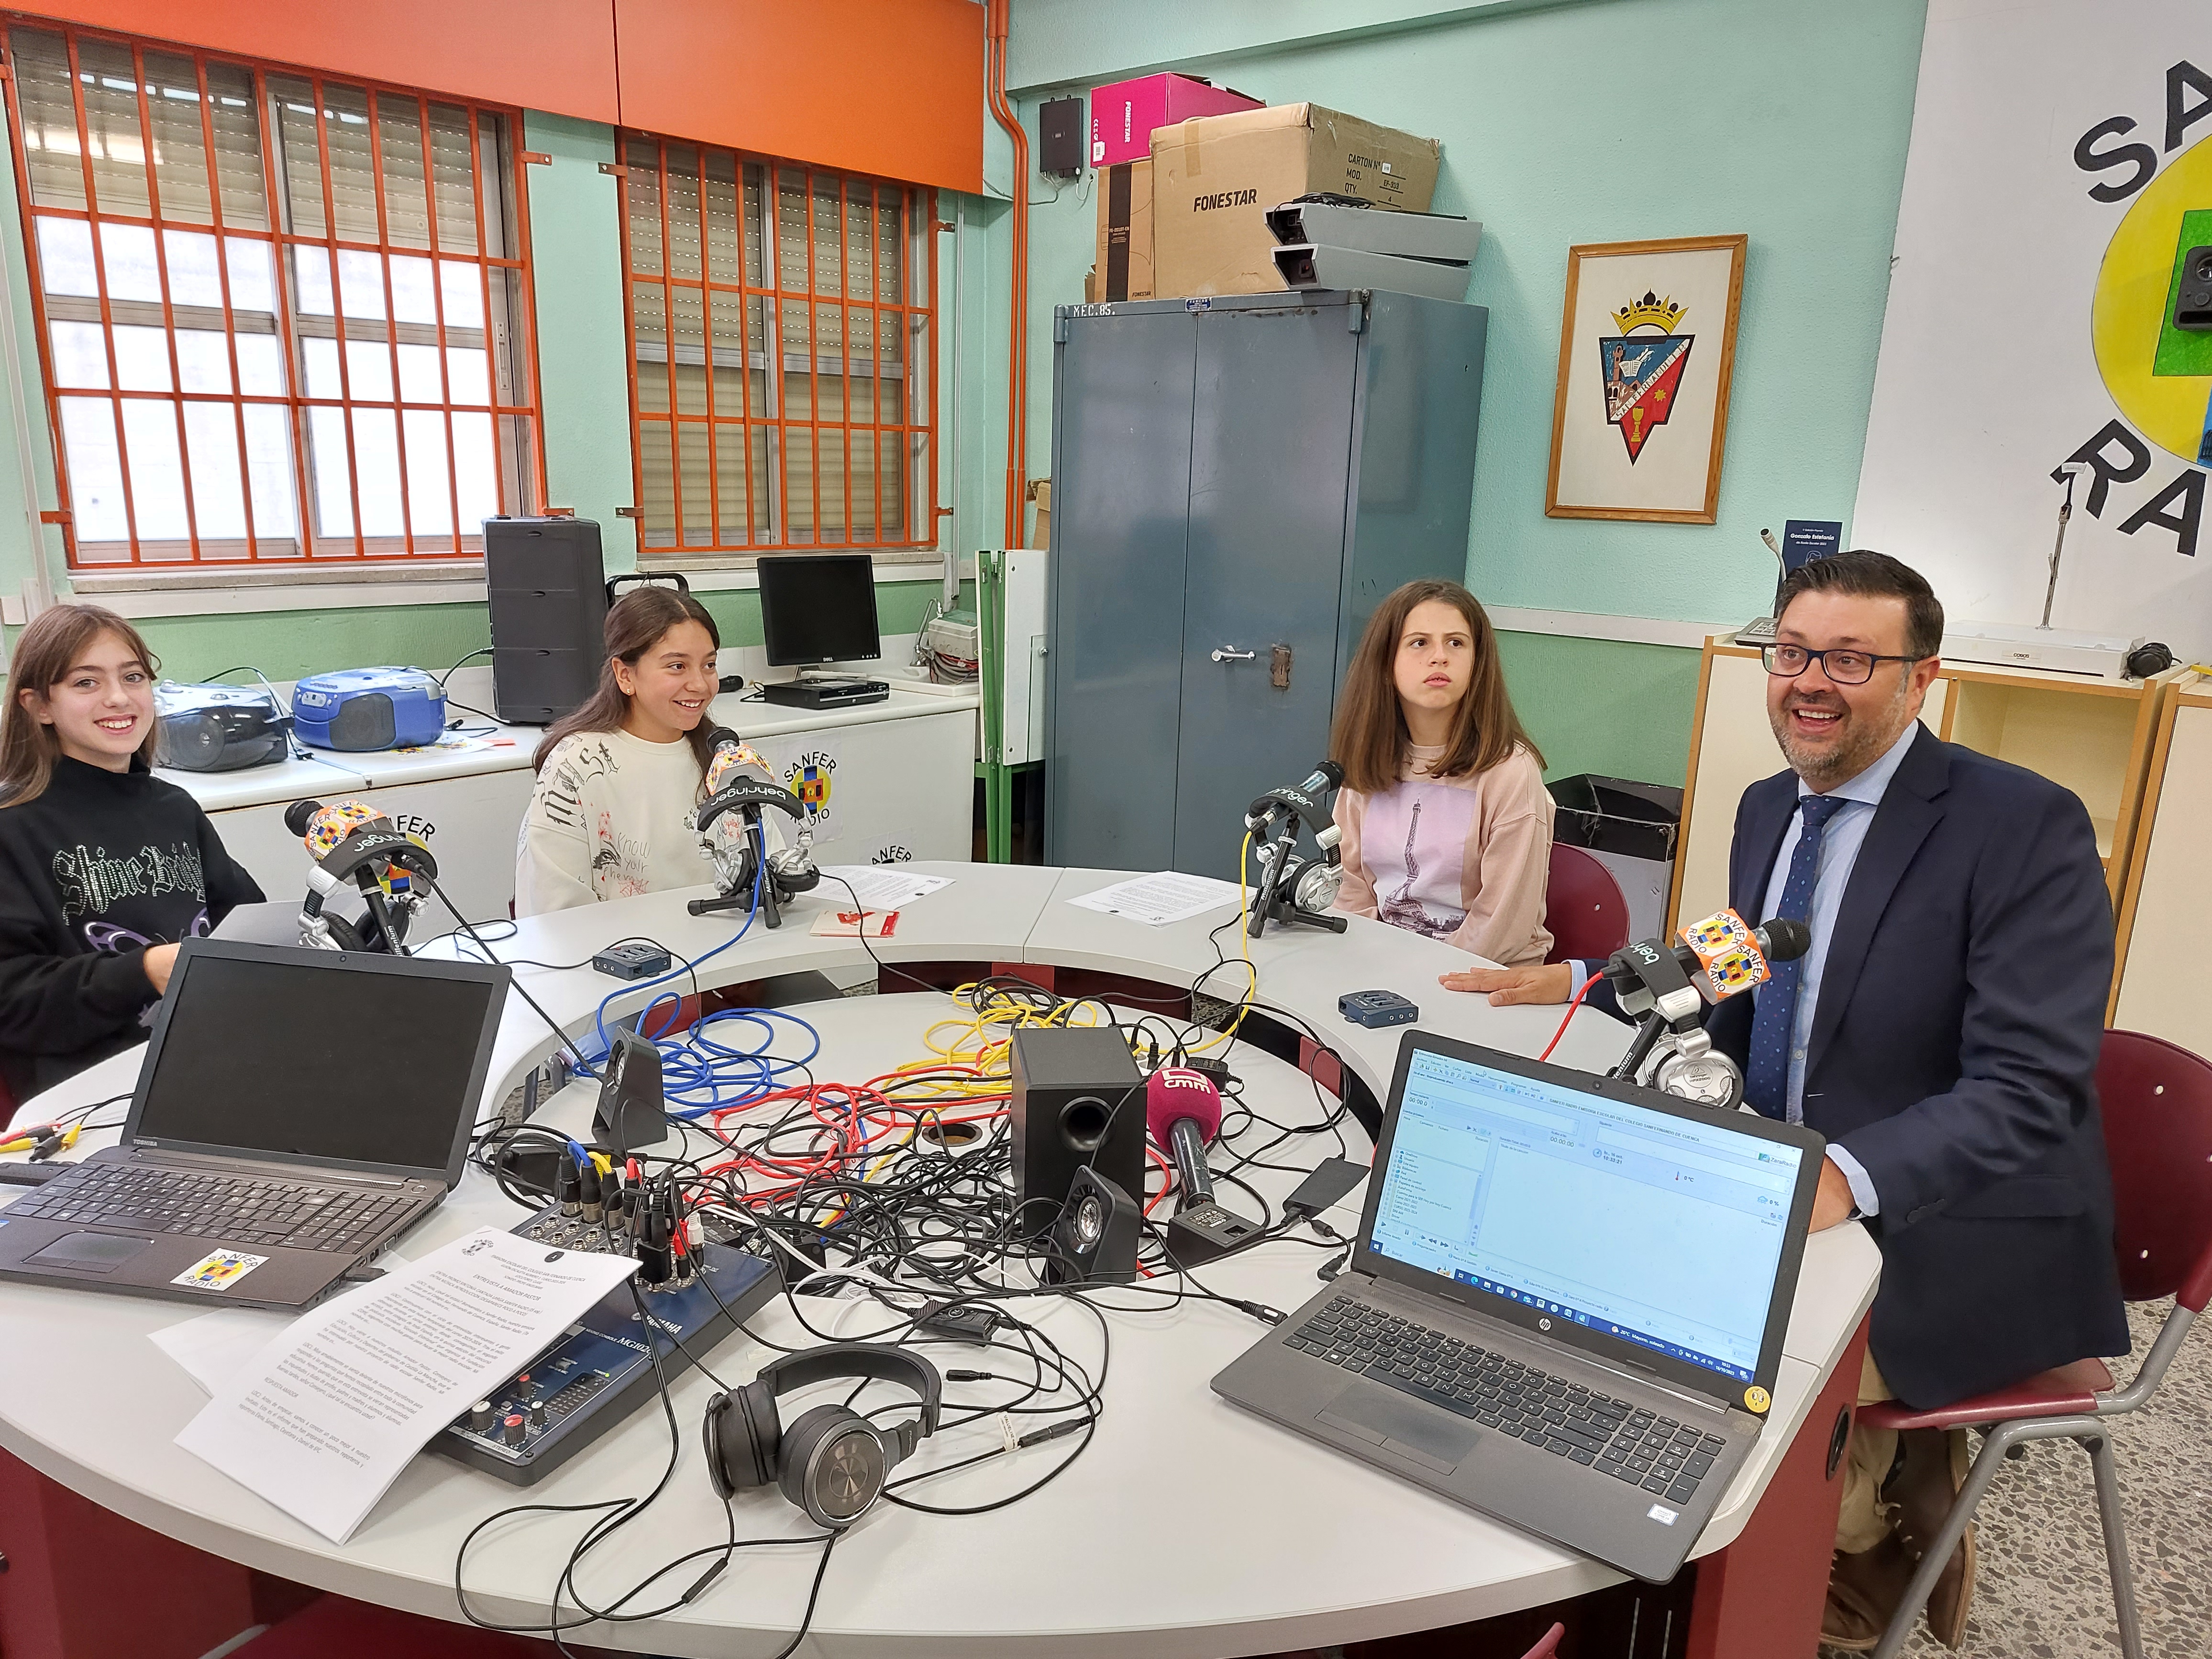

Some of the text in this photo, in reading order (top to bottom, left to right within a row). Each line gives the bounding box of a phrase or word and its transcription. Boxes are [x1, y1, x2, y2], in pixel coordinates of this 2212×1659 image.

[1349, 154, 1372, 168] CARTON
[1346, 168, 1361, 180] MOD.
[1345, 183, 1357, 194] QTY.
[1194, 189, 1257, 212] FONESTAR
[1616, 404, 1631, 418] SAN
[784, 752, 837, 782] SANFER
[711, 786, 786, 806] behringer
[53, 844, 147, 926] Shine
[1715, 914, 1744, 945] SANFER
[1689, 928, 1707, 953] RADIO
[1737, 945, 1762, 983] SANFER
[1710, 962, 1725, 992] RADIO
[1578, 1106, 1596, 1114] EMISORA
[1625, 1118, 1643, 1127] COLEGIO
[133, 1139, 157, 1147] TOSHIBA
[1770, 1158, 1797, 1168] ZaraRadio
[207, 1253, 258, 1268] SANFER
[184, 1275, 221, 1288] RADIO
[473, 1273, 541, 1302] ENTREVISTA AMADOR PASTOR
[264, 1376, 299, 1398] RESPUESTA AMADOR
[361, 1410, 375, 1421] usted?
[261, 1395, 272, 1404] Antes
[293, 1414, 305, 1423] vamos
[309, 1423, 323, 1434] conocer
[329, 1435, 339, 1443] poco
[339, 1440, 352, 1450] mejor
[354, 1449, 371, 1461] nuestro
[1004, 1415, 1015, 1439] VALUELINE
[298, 1437, 310, 1447] Daniel
[305, 1431, 324, 1445] preparado
[324, 1442, 340, 1454] nuestros
[339, 1451, 360, 1466] reporteros
[492, 1444, 510, 1454] STEREO
